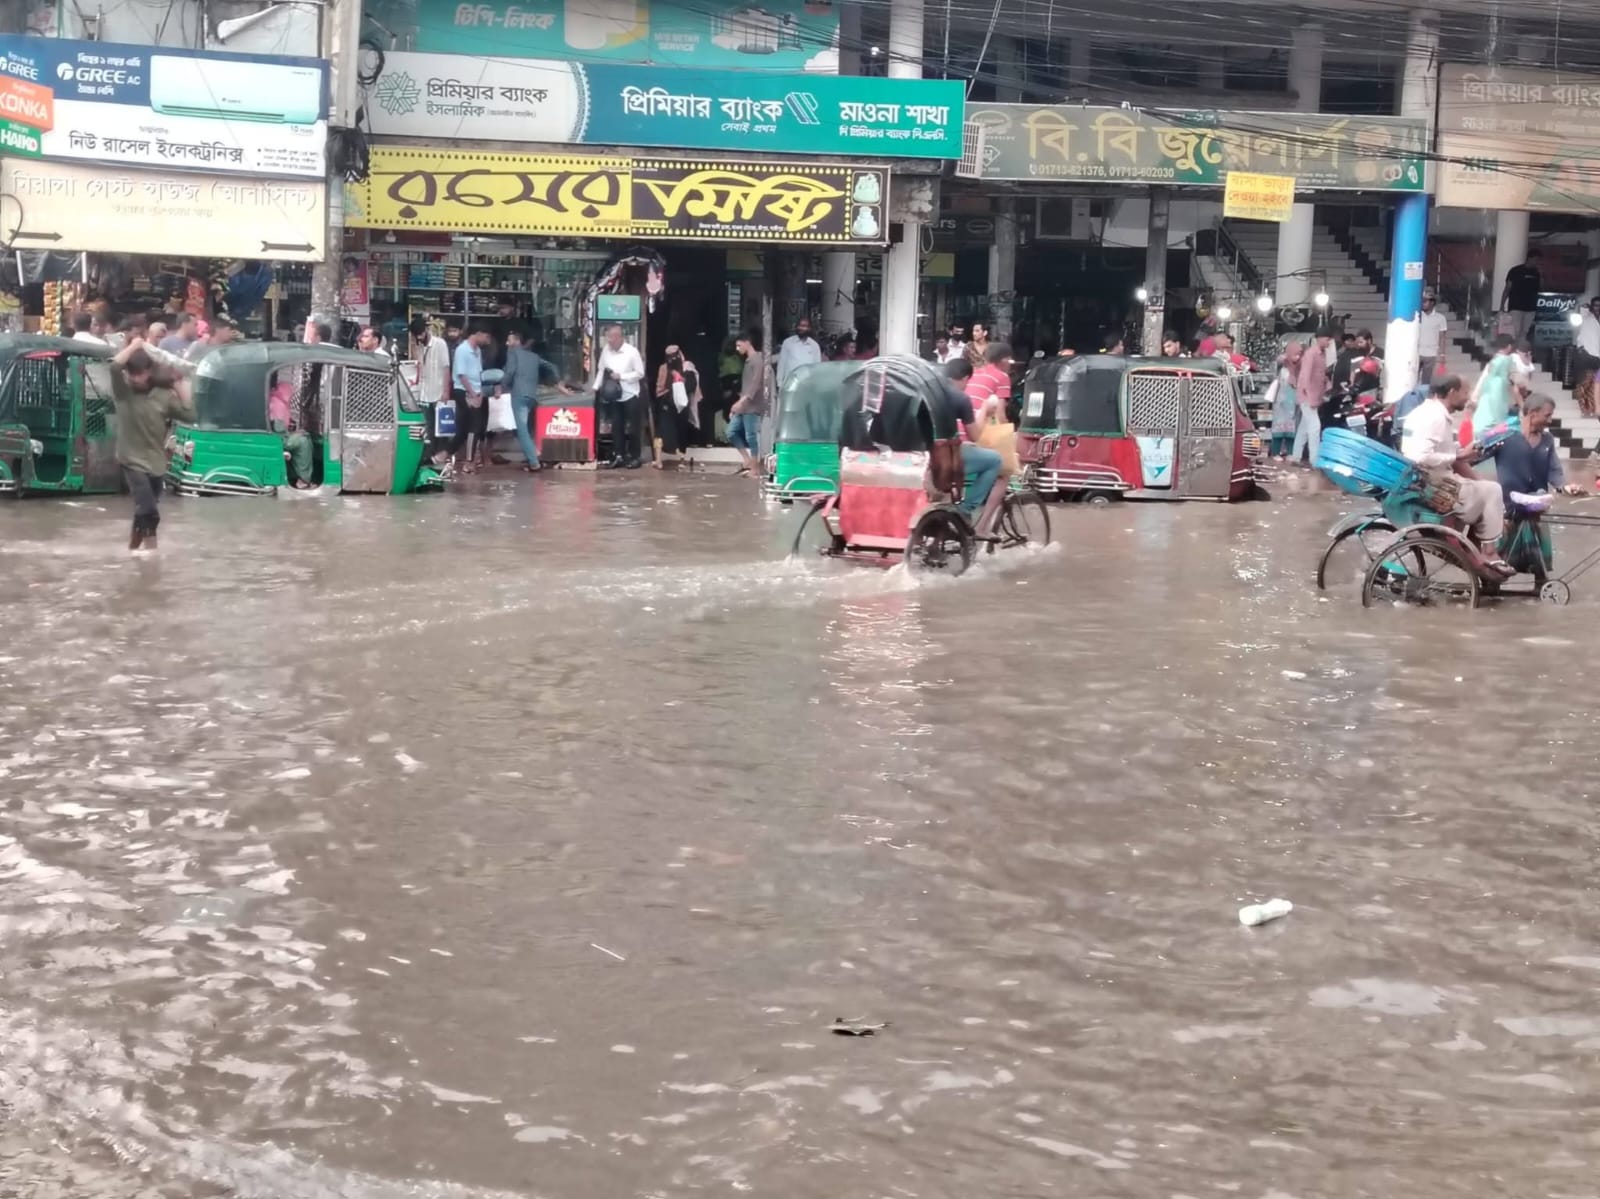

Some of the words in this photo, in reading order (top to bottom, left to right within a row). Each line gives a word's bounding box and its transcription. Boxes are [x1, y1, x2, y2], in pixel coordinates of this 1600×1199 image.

[455, 4, 556, 29] টিপি-লিংক
[8, 61, 39, 80] GREE
[76, 67, 127, 84] GREE
[127, 75, 141, 86] AC
[427, 78, 494, 101] প্রিমিয়ার
[500, 86, 548, 104] ব্যাংক
[1462, 72, 1545, 103] প্রিমিয়ার
[0, 92, 47, 119] KONKA
[426, 101, 485, 117] ইসলামিক
[620, 86, 713, 119] প্রিমিয়ার
[718, 97, 784, 121] ব্যাংক
[839, 102, 900, 124] মাওনা
[905, 104, 950, 126] শাখা
[753, 123, 777, 134] প্রথম
[69, 130, 97, 150] নিউ
[102, 137, 151, 155] রাসেল
